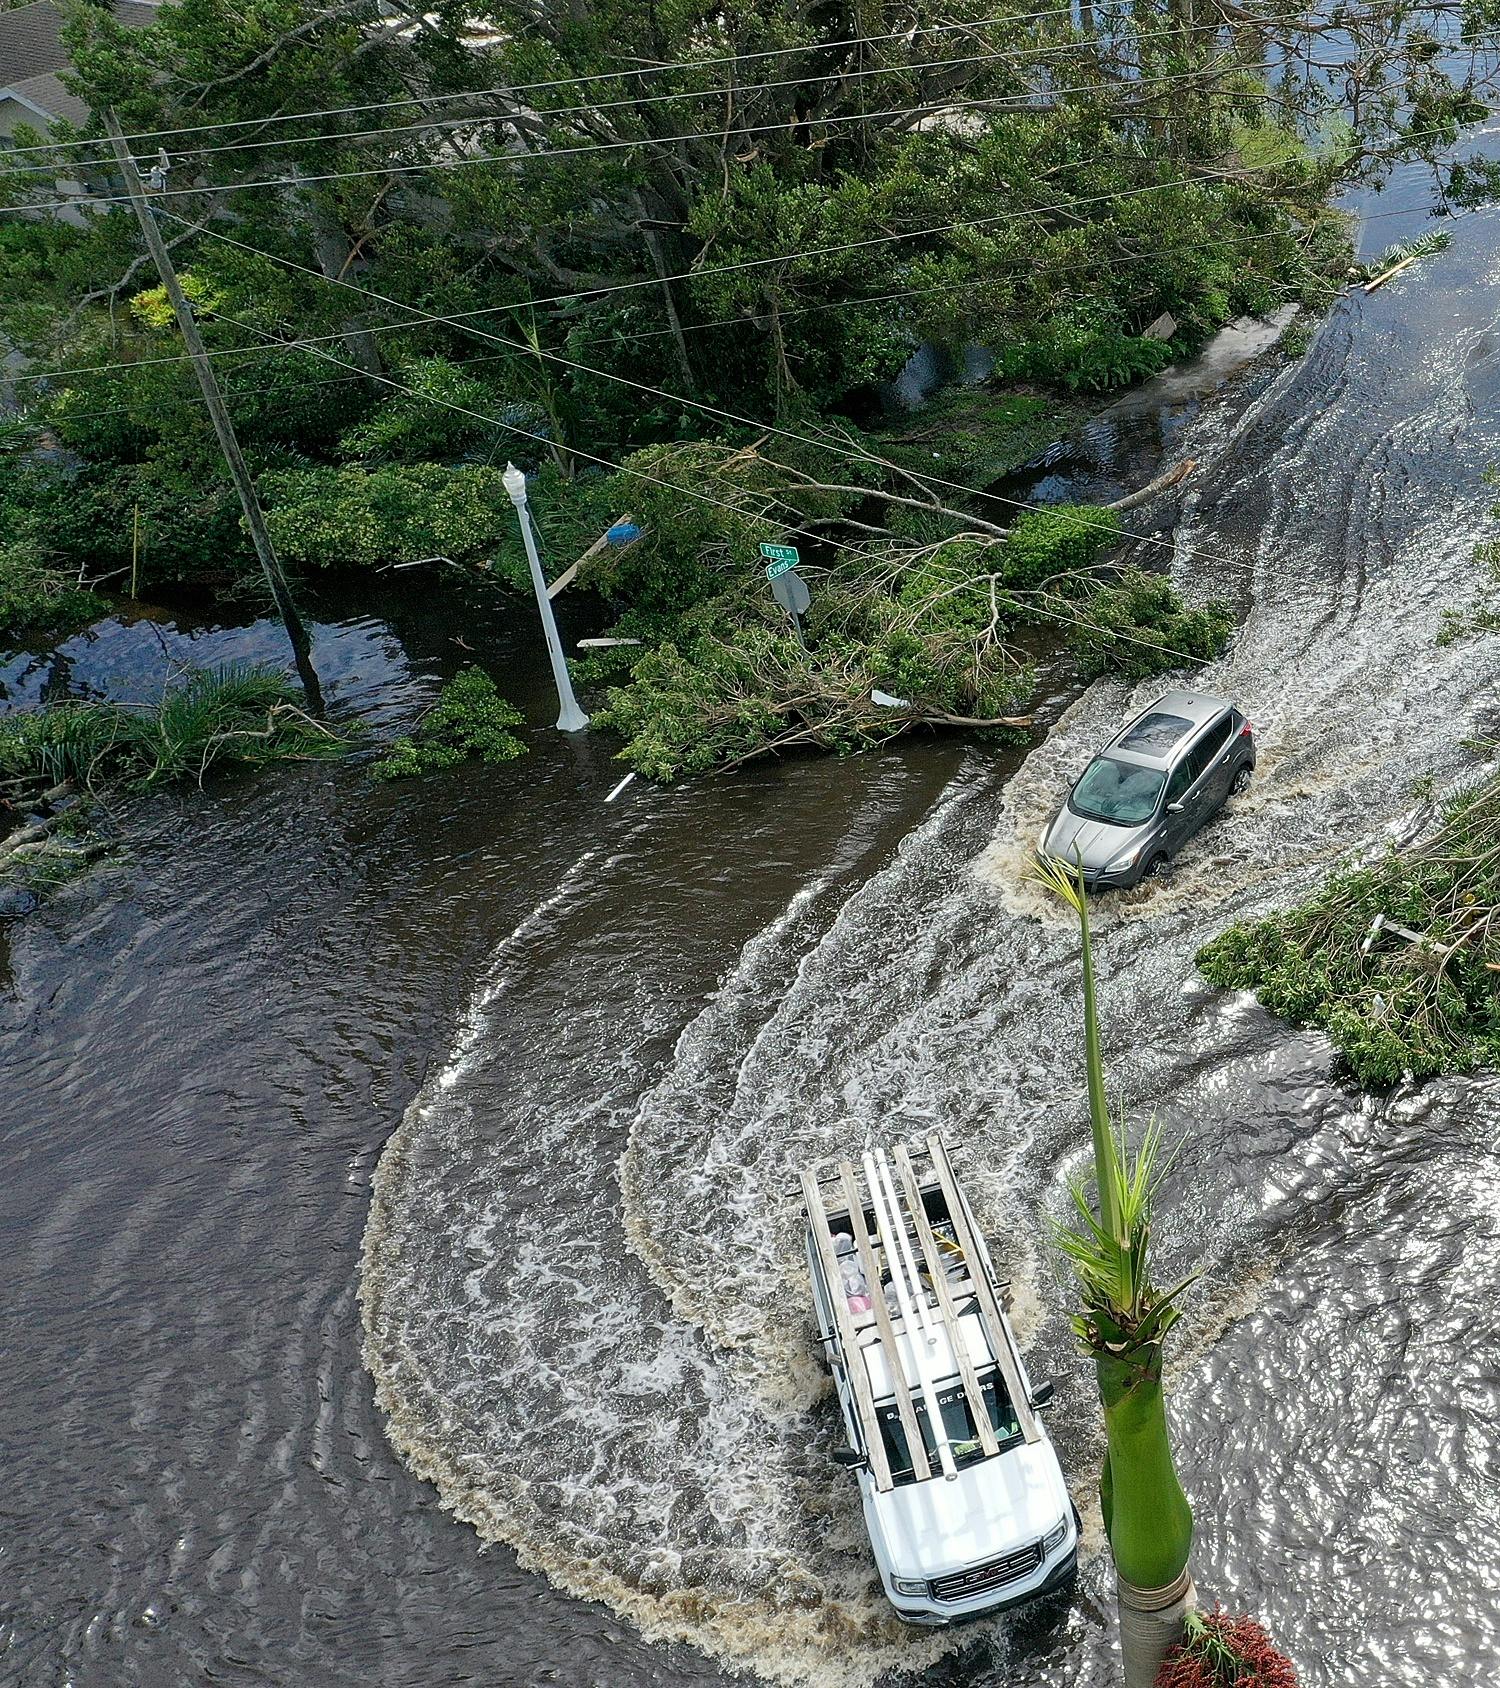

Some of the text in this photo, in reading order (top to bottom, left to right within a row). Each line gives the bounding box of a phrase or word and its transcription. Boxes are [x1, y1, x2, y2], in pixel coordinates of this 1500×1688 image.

[765, 545, 785, 558] First
[769, 560, 788, 577] Evans
[965, 1561, 1009, 1583] GMC
